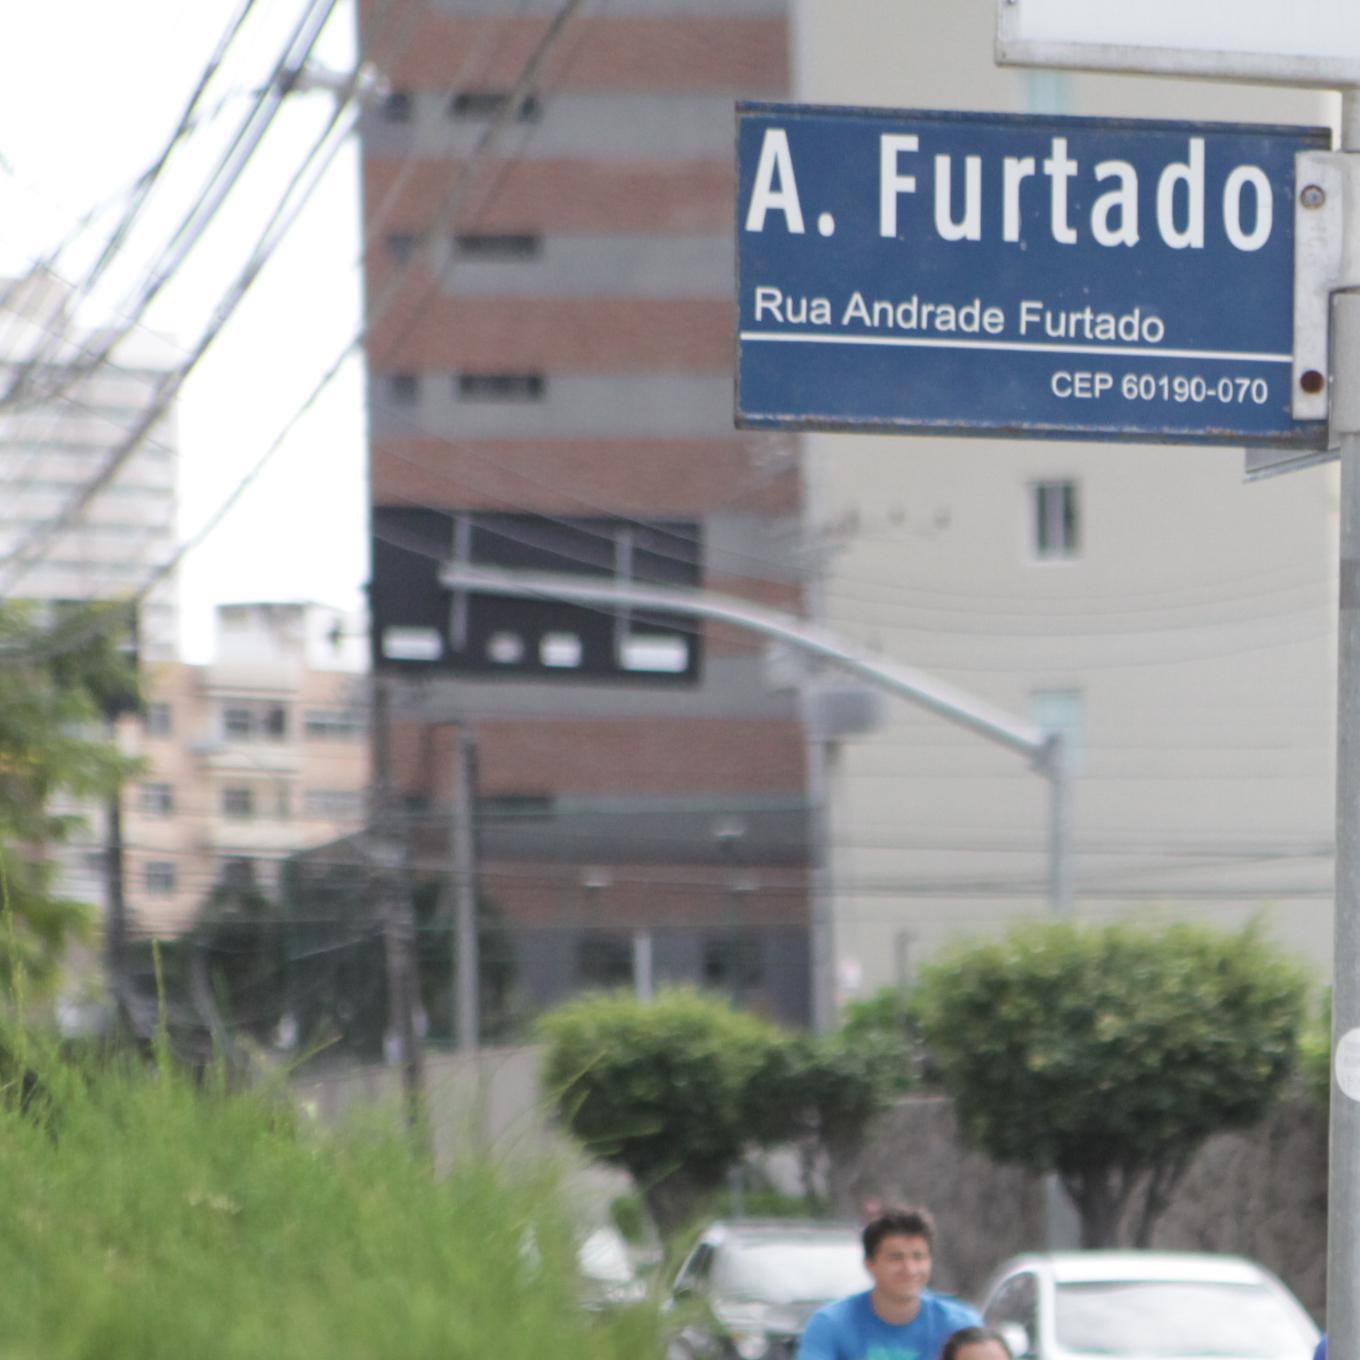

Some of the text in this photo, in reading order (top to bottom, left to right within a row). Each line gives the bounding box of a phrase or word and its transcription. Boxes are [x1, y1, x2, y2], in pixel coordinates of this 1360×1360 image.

[744, 127, 1275, 253] A. Furtado
[753, 287, 1166, 344] Rua Andrade Furtado
[1050, 372, 1269, 405] CEP 60190-070
